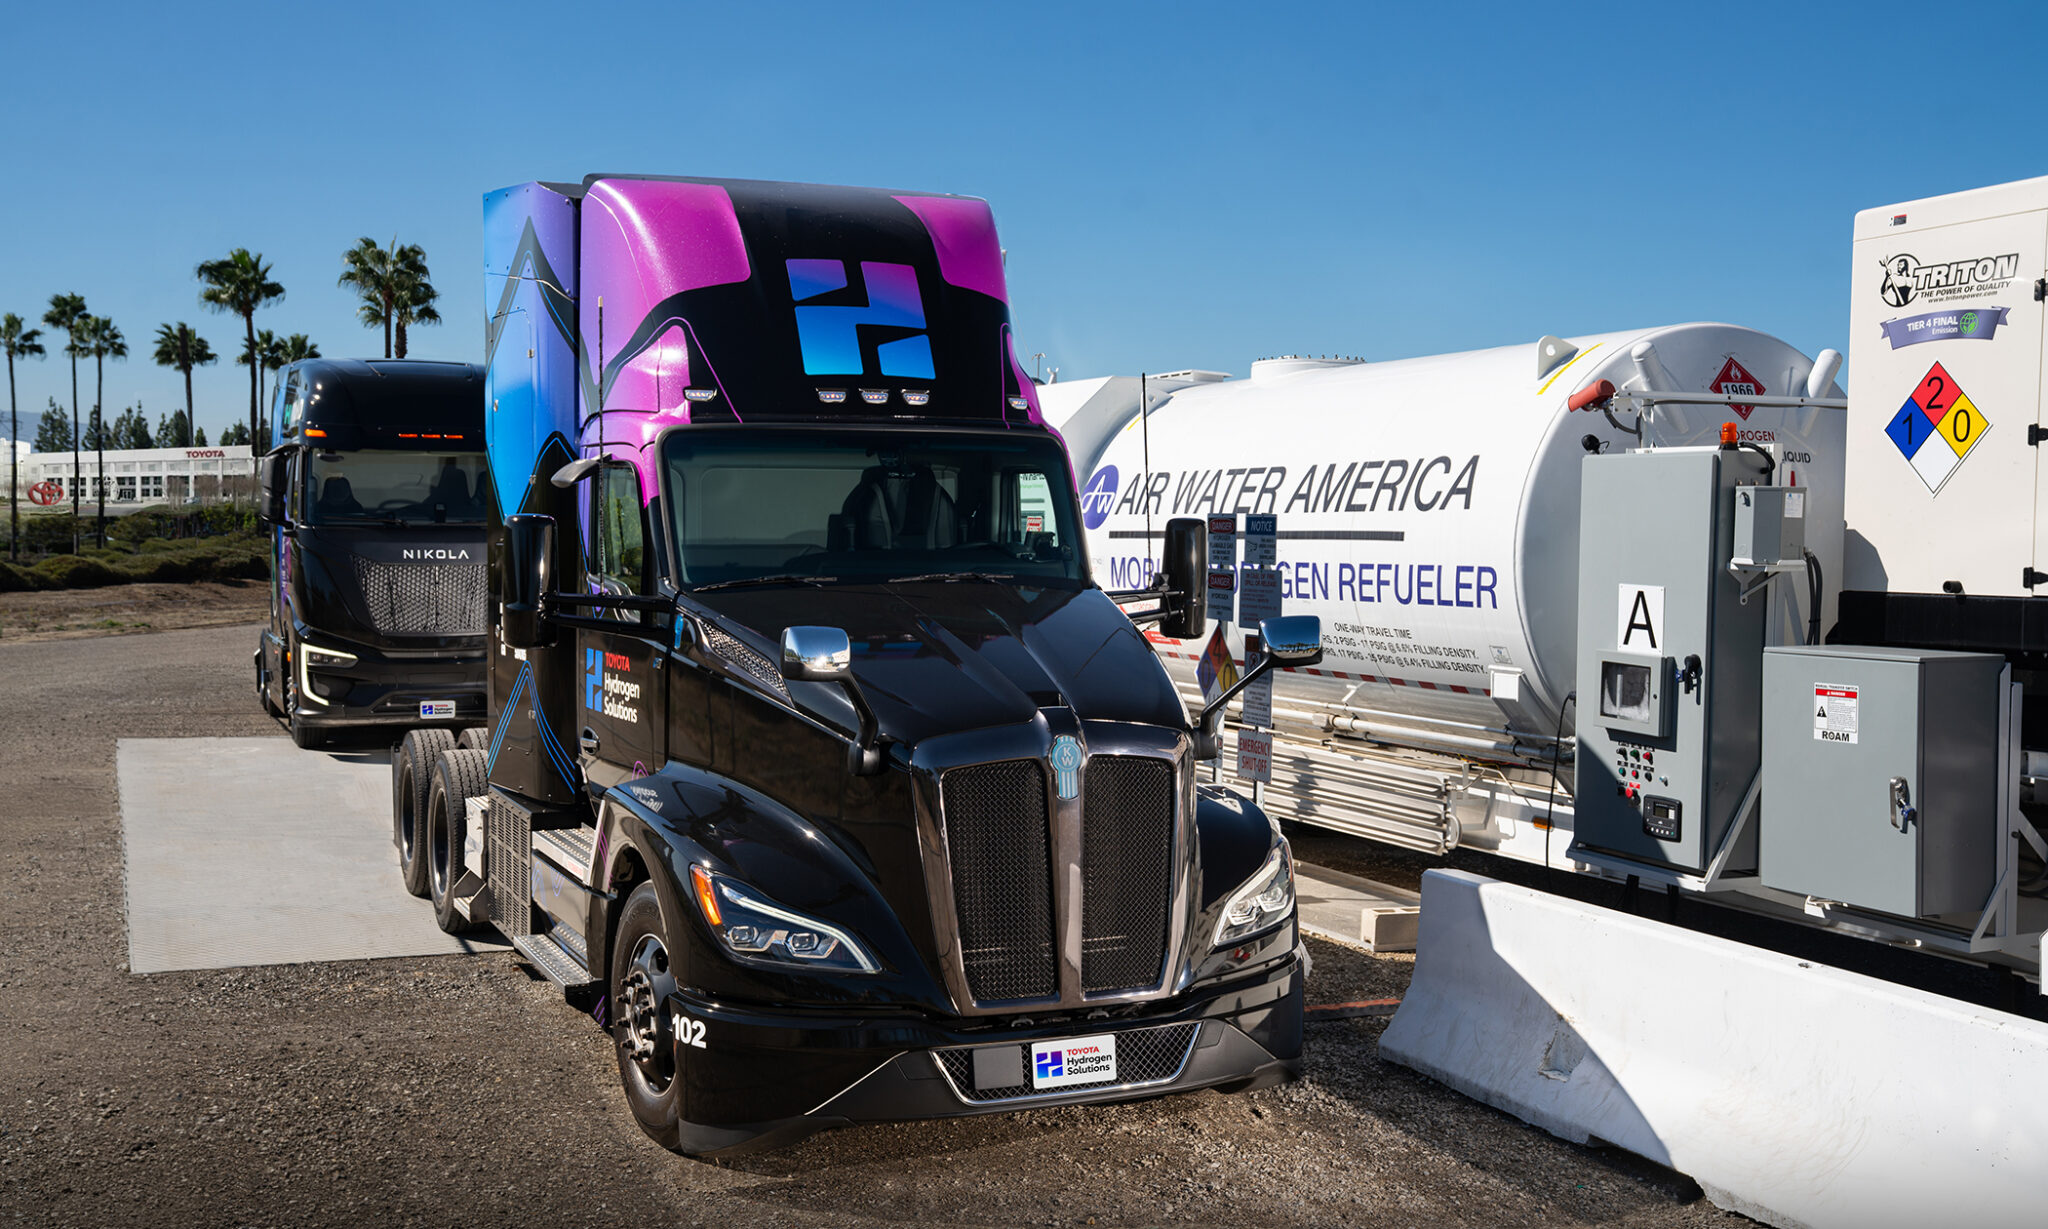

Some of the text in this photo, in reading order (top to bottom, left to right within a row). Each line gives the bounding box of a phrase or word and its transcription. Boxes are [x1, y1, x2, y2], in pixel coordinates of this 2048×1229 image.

[1913, 253, 2019, 291] TRITON
[1920, 281, 2012, 299] THE POWER OF QUALITY
[1928, 290, 1998, 304] www.tritonpower.com
[1907, 315, 1958, 332] TIER 4 FINAL
[1932, 326, 1958, 335] Emission
[1723, 384, 1754, 396] 1966
[1926, 376, 1944, 410] 2
[1902, 408, 1971, 446] 1 0
[186, 450, 225, 458] TOYOTA
[1115, 455, 1480, 515] AIR WATER AMERICA
[1211, 521, 1233, 531] DANGER
[1250, 520, 1273, 532] NOTICE
[403, 549, 469, 559] NIKOLA
[1111, 556, 1160, 590] MOBI
[1210, 576, 1231, 587] DANGER
[1339, 563, 1498, 609] REFUELER
[1623, 590, 1657, 649] A
[1334, 622, 1412, 639] ONE-WAY TRAVEL TIME
[1213, 636, 1222, 664] 4
[1334, 635, 1340, 645] 2
[1339, 636, 1356, 647] PSIG
[1369, 640, 1387, 651] PSIG
[1388, 642, 1397, 654] @
[1413, 644, 1443, 656] FILLING
[1442, 646, 1479, 660] DENSITY.
[605, 652, 630, 672] TOYOTA
[1347, 649, 1365, 660] PSIG
[1377, 653, 1395, 665] PSIG
[1395, 656, 1405, 667] @
[1421, 659, 1451, 671] FILLING
[1451, 661, 1488, 675] DENSITY.
[1202, 660, 1210, 689] 0
[1223, 663, 1232, 692] 0
[604, 672, 640, 702] Hydrogen
[604, 696, 638, 723] Solutions
[1822, 730, 1850, 742] ROAM
[1239, 737, 1270, 757] EMERGENCY
[1242, 755, 1268, 774] SHUT-OFF
[672, 1013, 707, 1049] 102
[1066, 1046, 1100, 1057] TOYOTA
[1067, 1054, 1112, 1067] Hydrogen
[1067, 1064, 1110, 1076] Solutions
